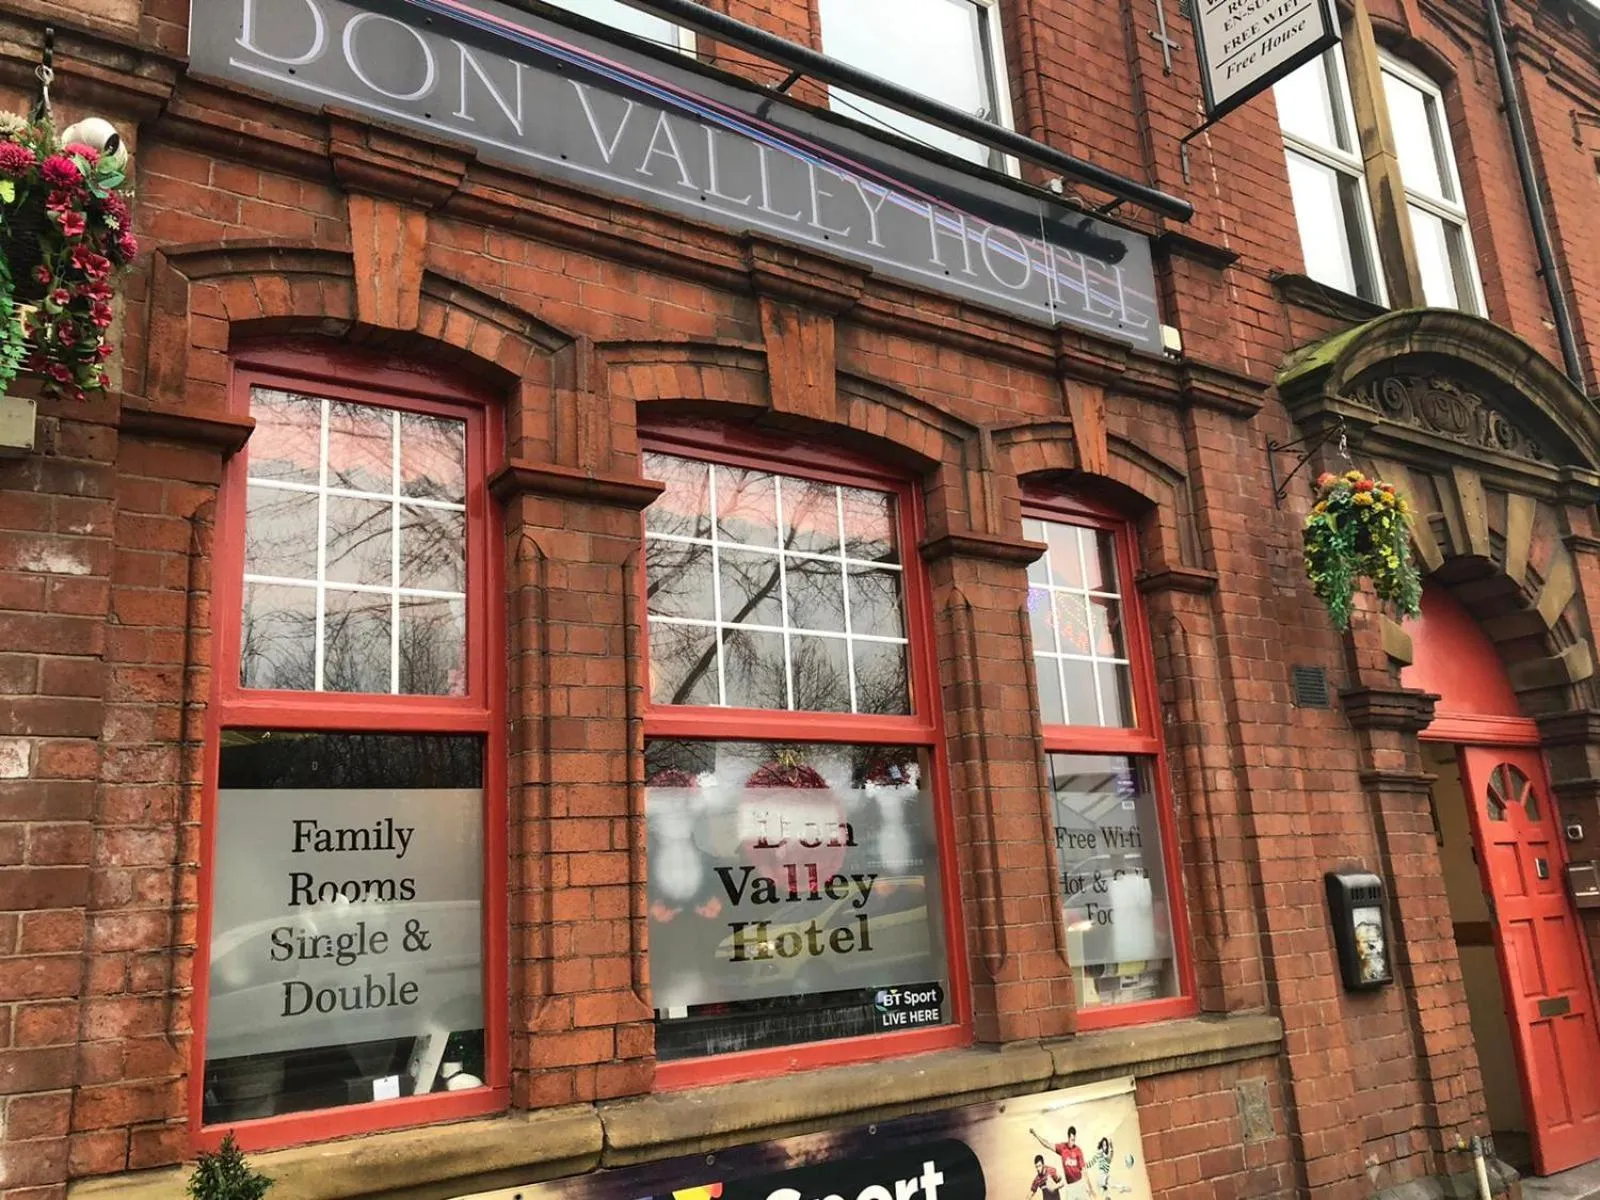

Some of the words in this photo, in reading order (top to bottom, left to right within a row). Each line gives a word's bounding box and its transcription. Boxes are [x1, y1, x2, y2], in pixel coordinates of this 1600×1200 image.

[1223, 22, 1260, 54] FREE
[1226, 51, 1256, 79] Free
[1261, 20, 1306, 56] House
[234, 0, 529, 136] DON
[569, 80, 893, 248] VALLEY
[926, 202, 1149, 328] HOTEL
[291, 818, 415, 859] Family
[1055, 826, 1097, 849] Free
[1101, 825, 1143, 849] Wi-fi
[288, 872, 416, 906] Rooms
[714, 863, 878, 909] Valley
[1093, 868, 1108, 894] &
[270, 922, 389, 966] Single
[402, 919, 432, 953] &
[728, 914, 874, 962] Hotel
[281, 972, 419, 1017] Double
[883, 993, 902, 1007] BT
[904, 988, 937, 1007] Sport
[882, 1011, 908, 1026] LIVE
[909, 1008, 940, 1023] HERE
